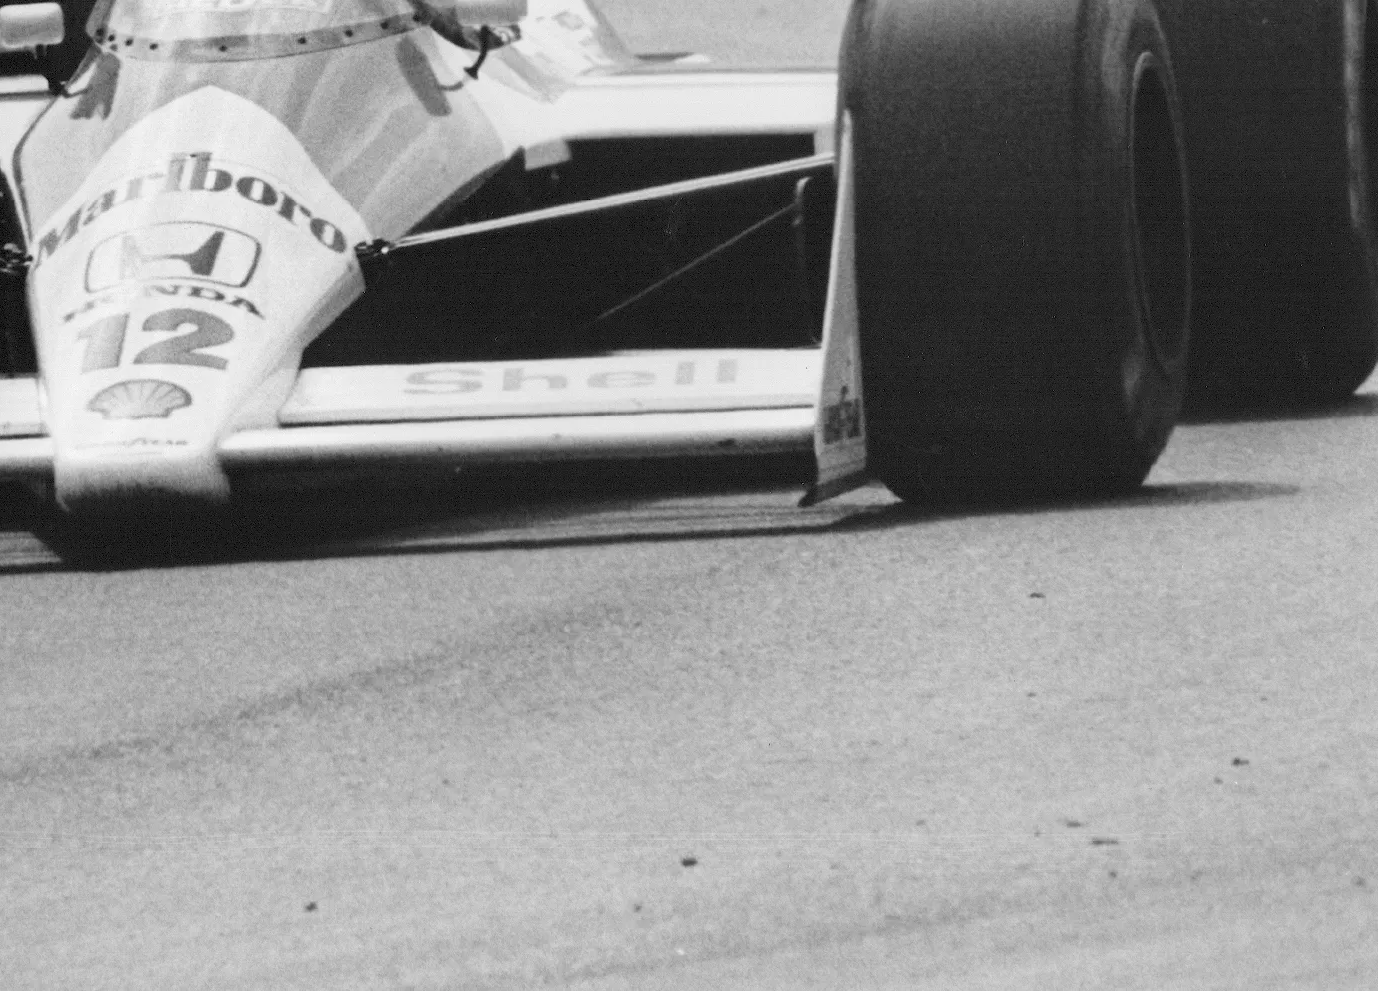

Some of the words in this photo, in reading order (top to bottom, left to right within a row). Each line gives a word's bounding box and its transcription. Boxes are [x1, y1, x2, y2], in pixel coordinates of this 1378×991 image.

[35, 150, 349, 260] Marlboro
[75, 307, 236, 374] 12
[402, 358, 740, 395] Shell
